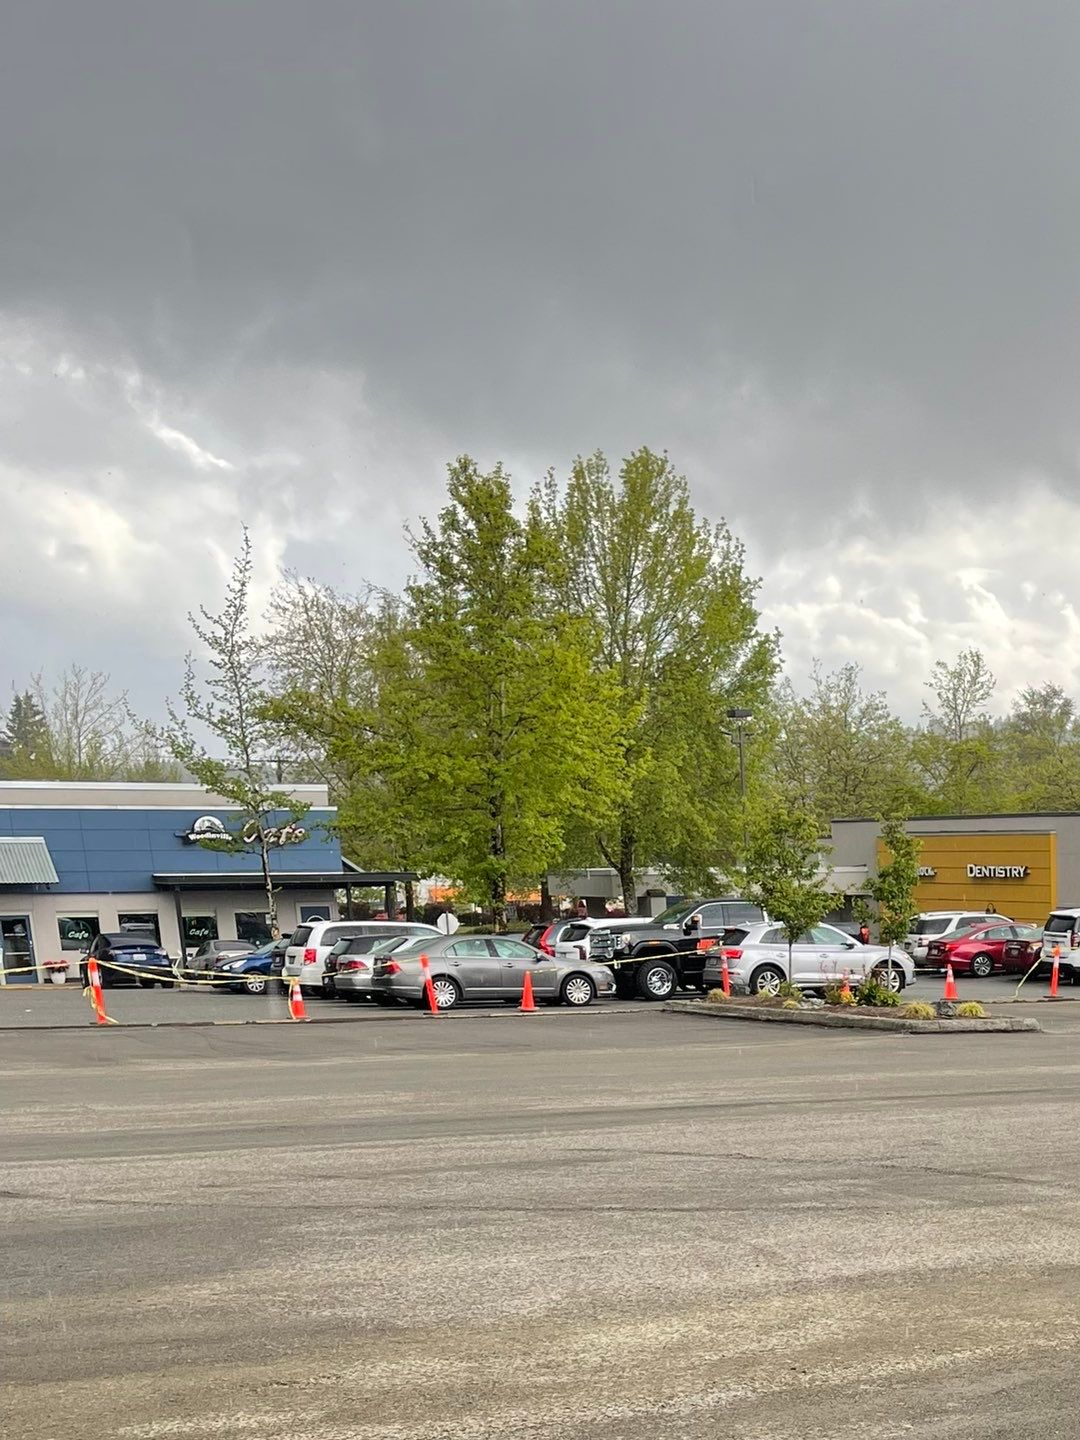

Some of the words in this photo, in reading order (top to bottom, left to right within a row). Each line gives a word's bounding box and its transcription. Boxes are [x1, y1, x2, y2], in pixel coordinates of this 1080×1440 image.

[966, 863, 1027, 878] DENTISTRY
[67, 930, 90, 940] Cafe
[189, 928, 210, 937] Cafe
